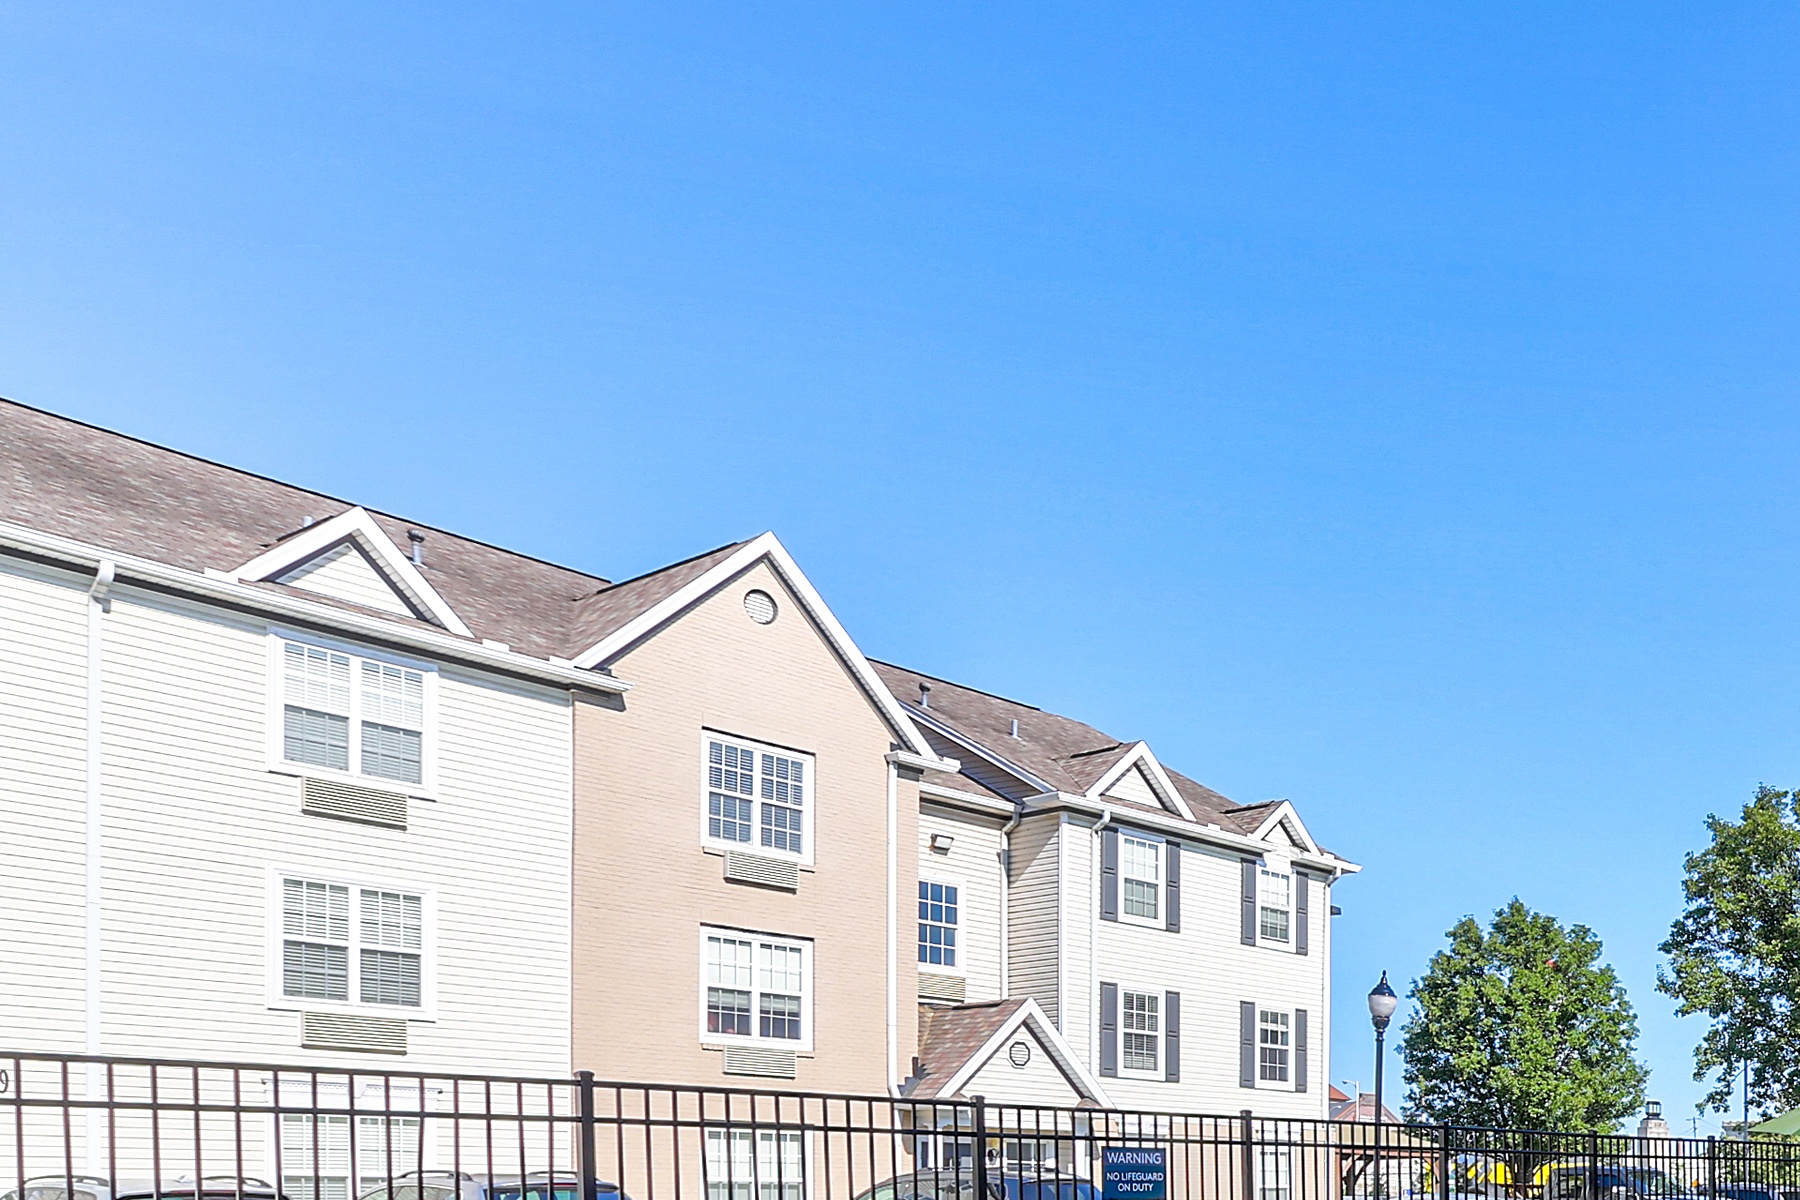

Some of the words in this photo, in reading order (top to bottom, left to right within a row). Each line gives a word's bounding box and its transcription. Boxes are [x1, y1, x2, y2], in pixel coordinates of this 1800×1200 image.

[1107, 1152, 1162, 1164] WARNING
[1106, 1172, 1120, 1181] NO
[1121, 1172, 1164, 1182] LIFEGUARD
[1117, 1183, 1131, 1192] ON
[1132, 1182, 1154, 1192] DUTY
